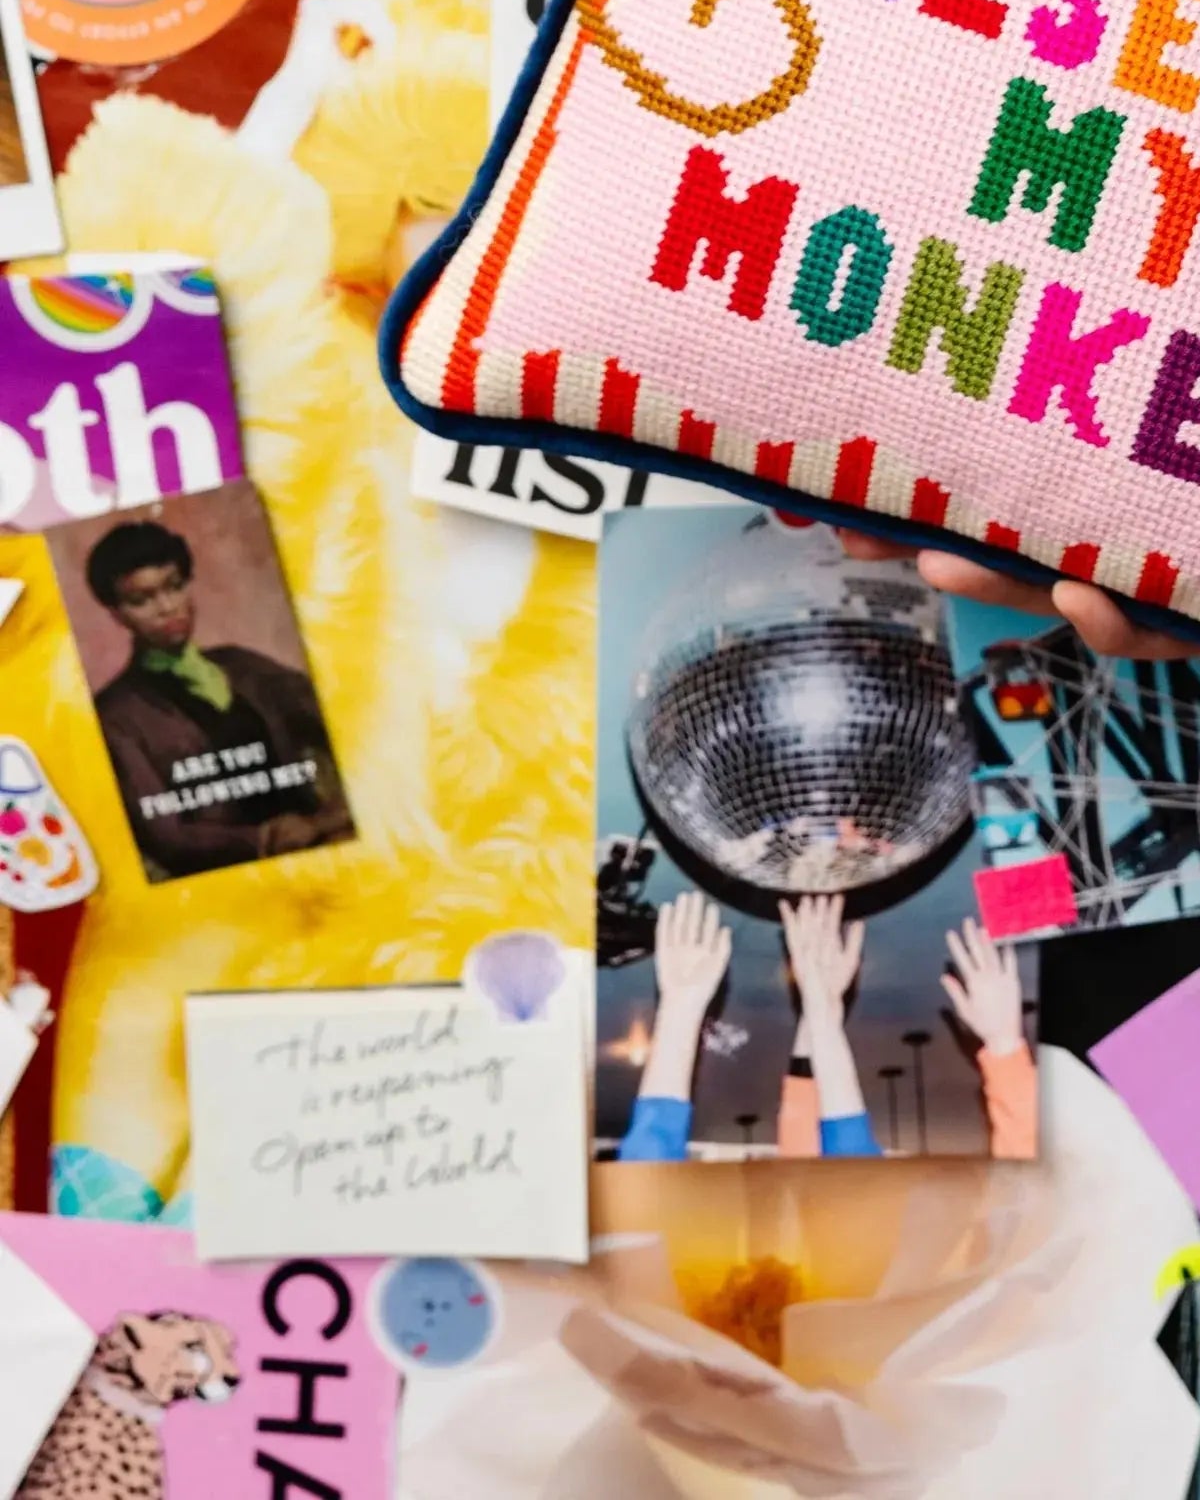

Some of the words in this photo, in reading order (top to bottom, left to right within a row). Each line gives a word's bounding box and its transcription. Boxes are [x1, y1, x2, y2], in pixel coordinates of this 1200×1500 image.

[171, 752, 221, 784] ARE
[218, 740, 268, 772] YOU
[139, 770, 272, 821] FOLLOWING
[358, 1003, 459, 1060] world
